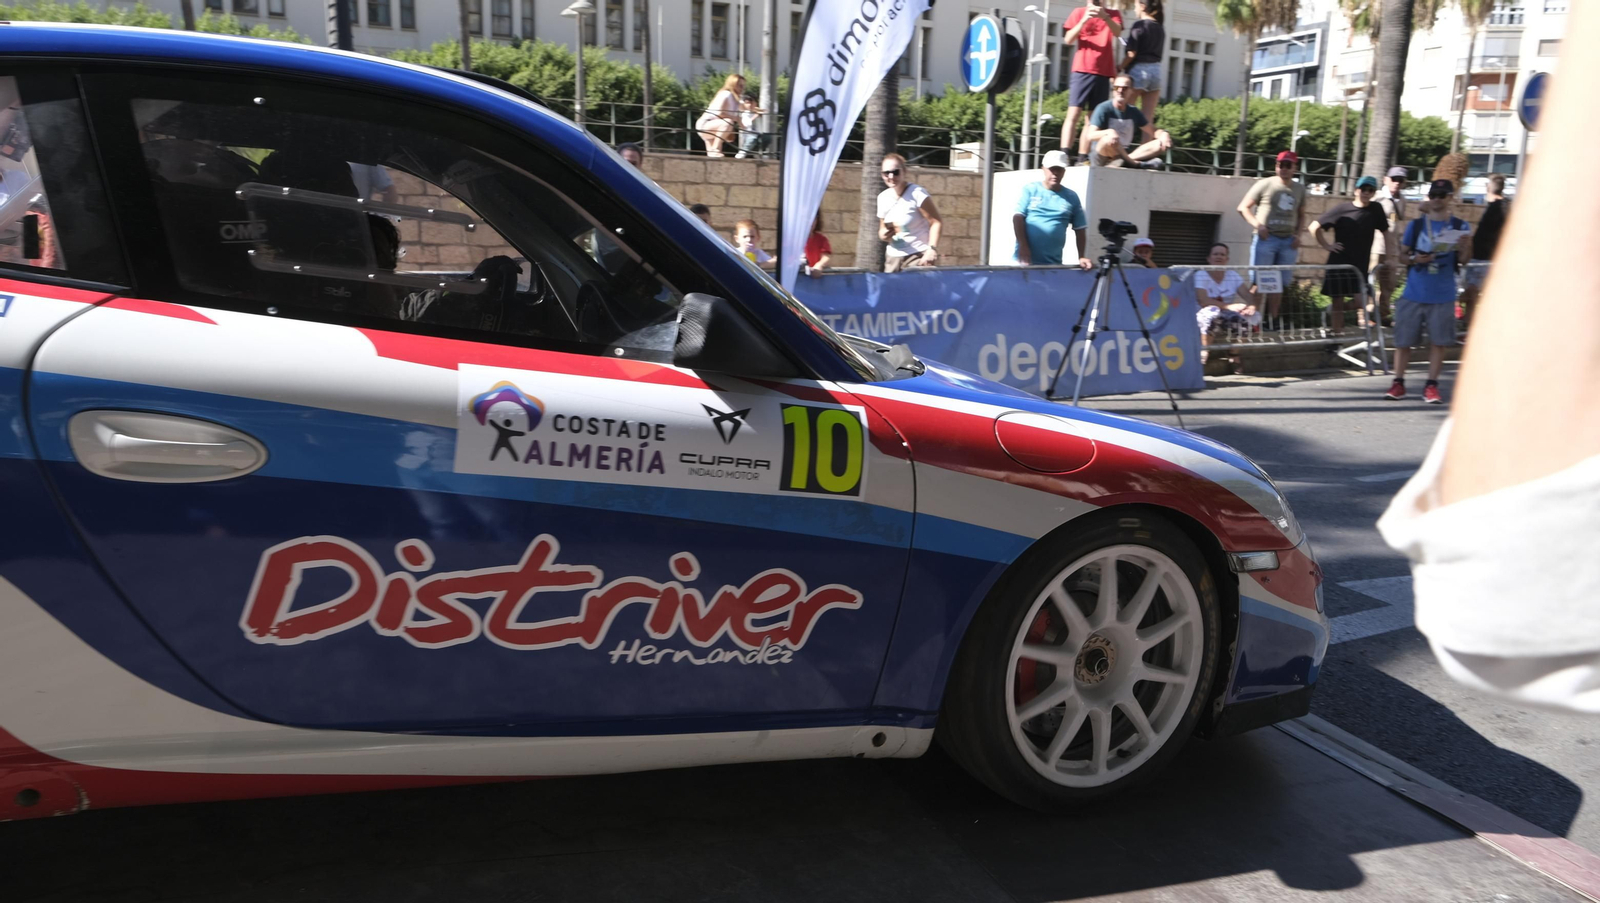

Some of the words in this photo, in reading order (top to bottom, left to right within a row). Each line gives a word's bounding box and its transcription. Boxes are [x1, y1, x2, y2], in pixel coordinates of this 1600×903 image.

[828, 0, 886, 86] dimo
[219, 223, 268, 240] OMP
[819, 308, 965, 338] TAMIENTO
[978, 331, 1184, 391] deportes
[553, 413, 630, 438] COSTA
[637, 422, 667, 441] DE
[523, 439, 667, 475] ALMERÍA
[679, 452, 771, 470] CUPRA
[782, 404, 865, 493] 10
[688, 467, 724, 478] INDALO
[725, 470, 760, 481] MOTOR
[239, 534, 863, 650] Distriver
[608, 635, 794, 665] Hernandez
